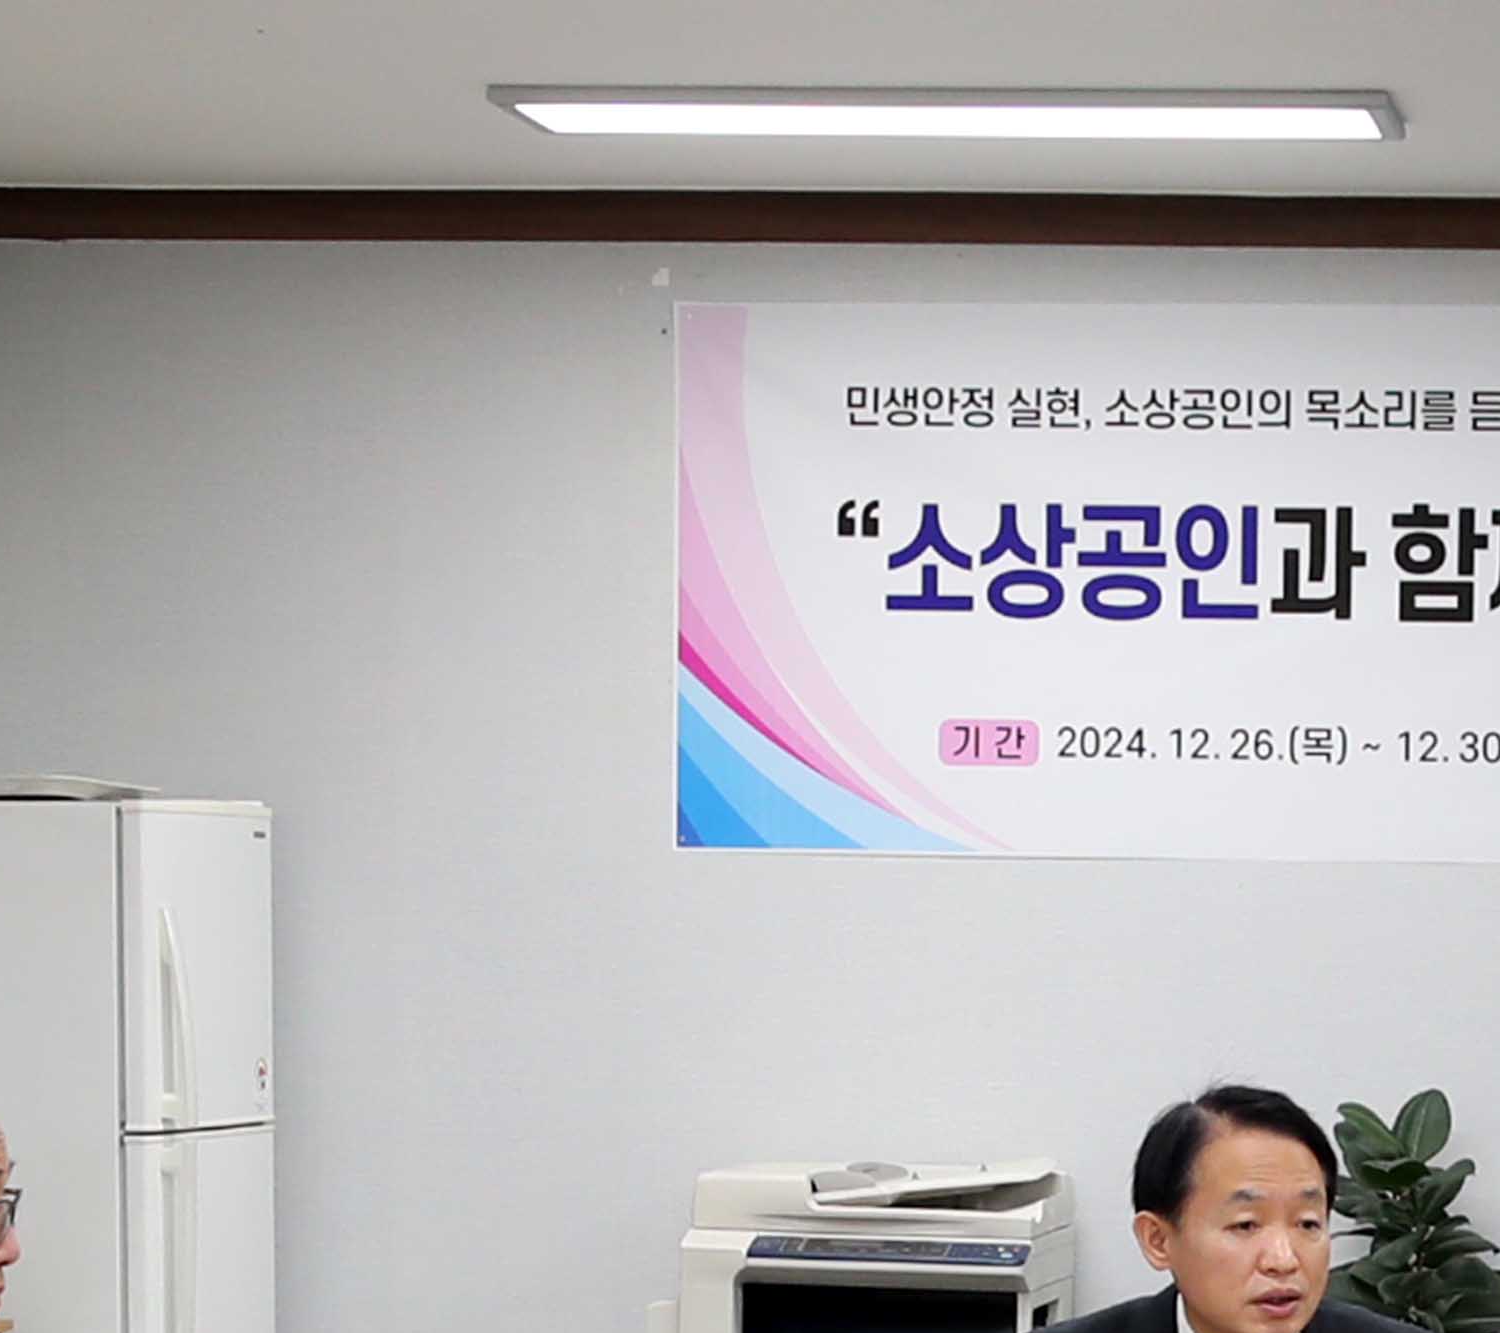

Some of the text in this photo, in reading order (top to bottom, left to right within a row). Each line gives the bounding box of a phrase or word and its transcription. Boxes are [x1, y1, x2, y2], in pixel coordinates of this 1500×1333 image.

[846, 386, 994, 428] 민생안정
[1008, 386, 1091, 430] 실현,
[1104, 388, 1291, 430] 소상공인의
[1305, 389, 1457, 432] 목소리를
